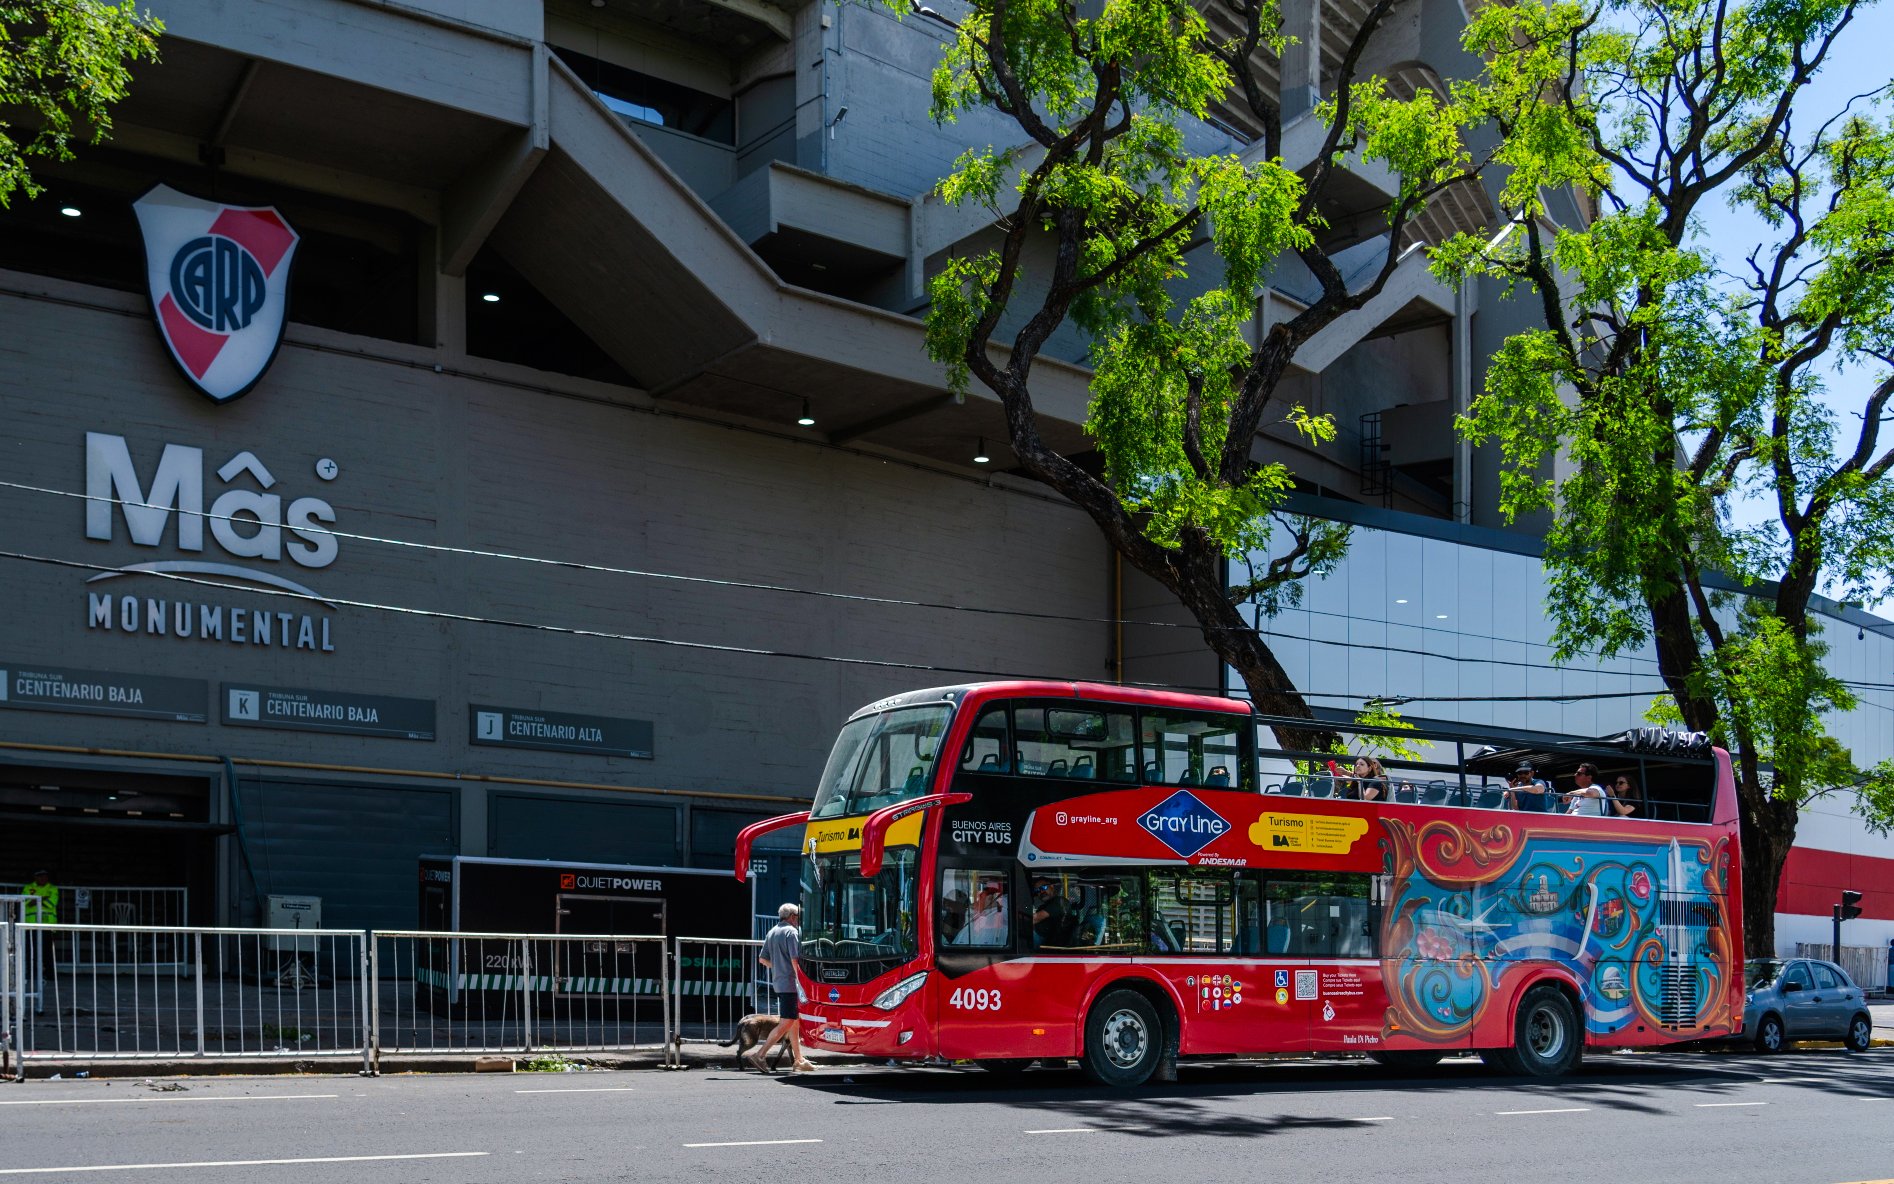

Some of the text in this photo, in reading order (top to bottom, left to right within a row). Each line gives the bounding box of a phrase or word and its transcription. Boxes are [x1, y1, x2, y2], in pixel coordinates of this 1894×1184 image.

[170, 236, 266, 331] CARP
[89, 592, 335, 651] MONUMENTAL
[18, 671, 63, 681] TRIBUNA SUR
[16, 679, 143, 704] CENTENARIO BAJA
[269, 692, 295, 700] TRIBUNA
[239, 697, 249, 715] K
[267, 699, 379, 723] CENTENARIO BAJA
[486, 719, 493, 735] J
[509, 720, 603, 743] CENTENARIO ALTA
[952, 820, 1012, 831] BUENOS AIRES
[1070, 815, 1118, 825] grayline_arg
[1268, 816, 1304, 828] Turismo
[818, 830, 845, 842] Turismo
[952, 831, 1012, 844] CITY BUS
[1272, 834, 1290, 847] BA
[1198, 857, 1247, 866] ANDESMAR
[577, 875, 662, 892] QUIETPOWER
[486, 954, 509, 968] 220
[693, 957, 741, 968] SULLAIR
[949, 987, 1002, 1011] 4093
